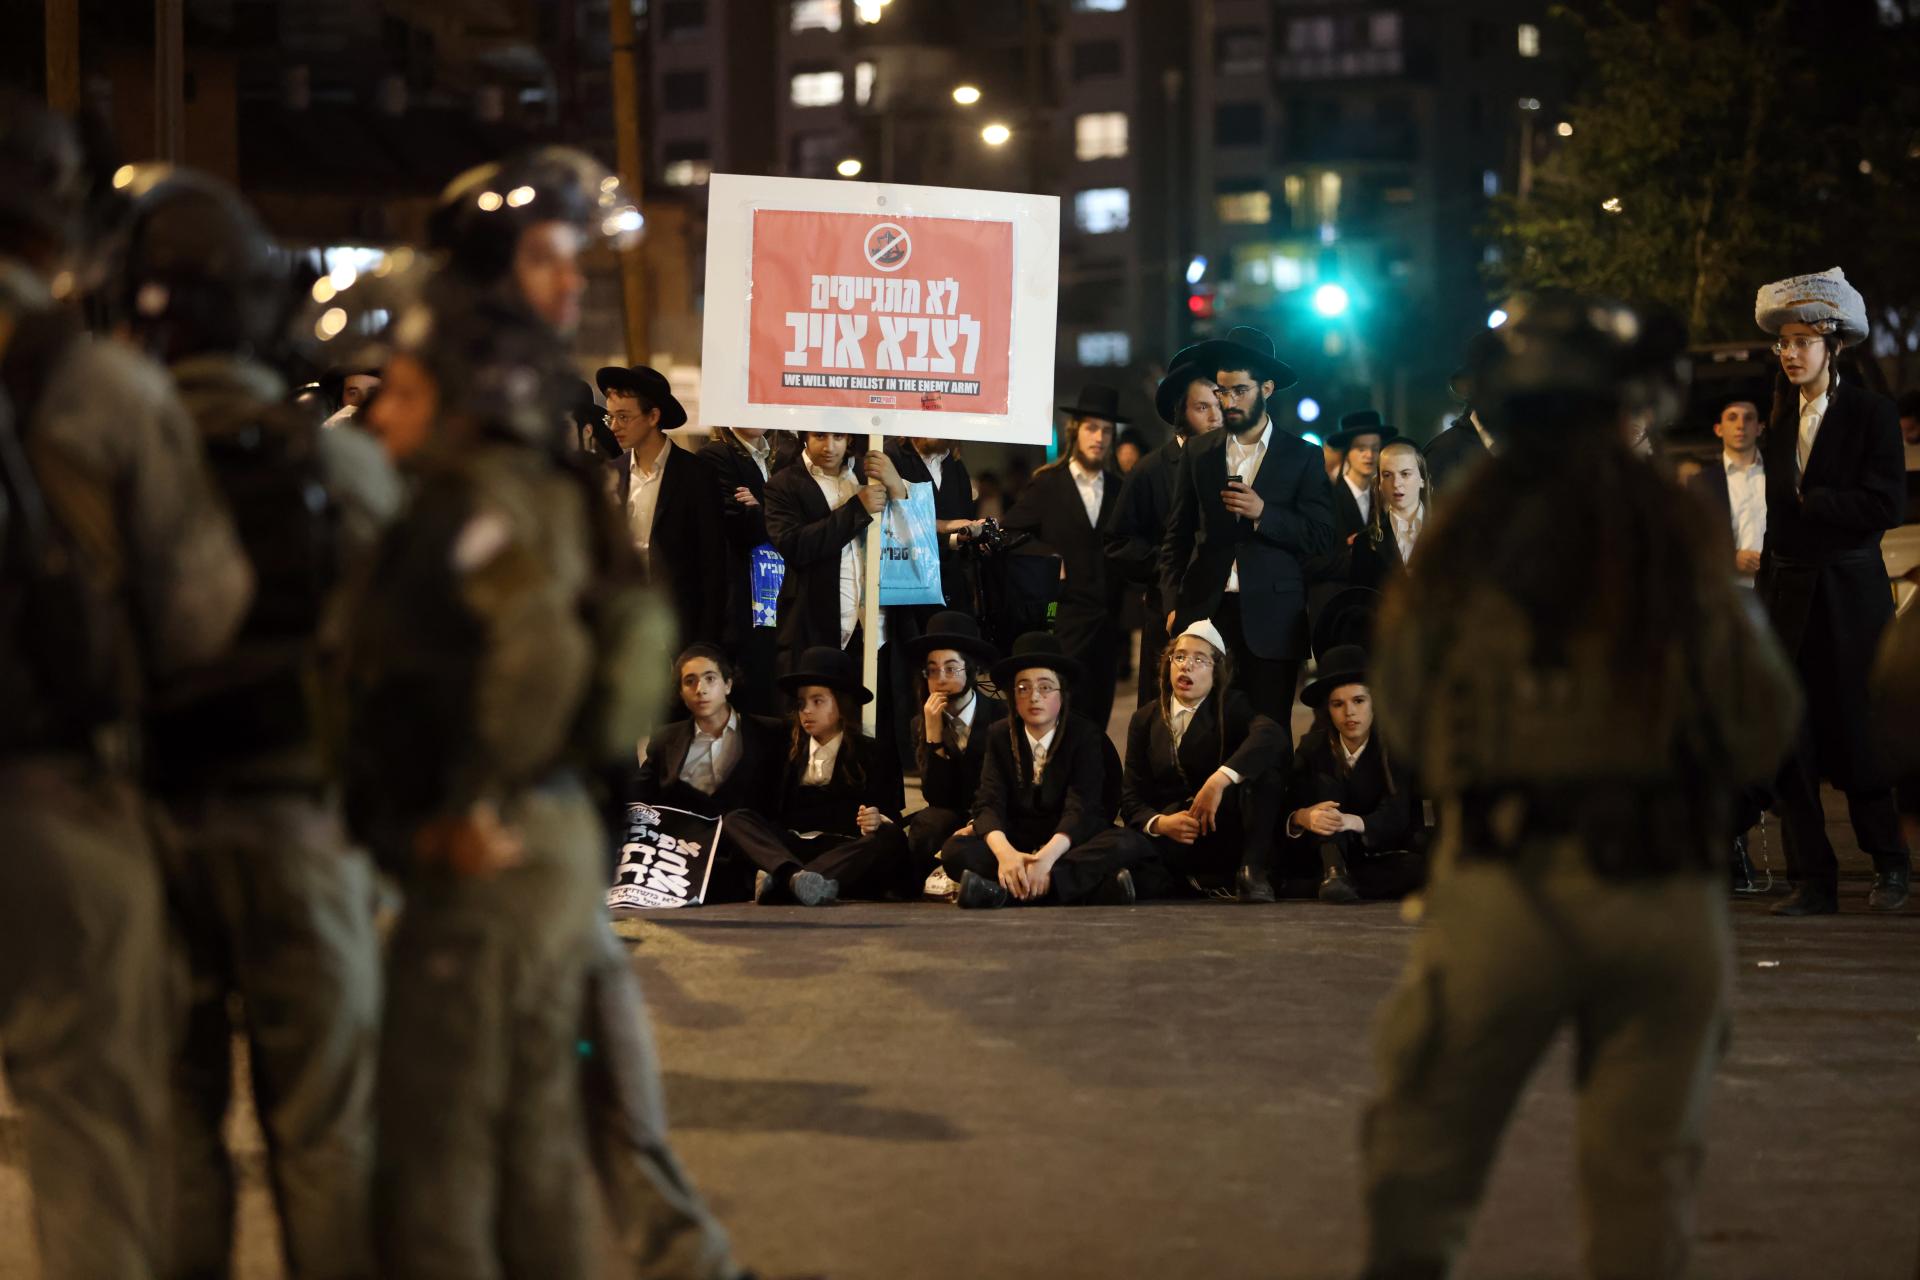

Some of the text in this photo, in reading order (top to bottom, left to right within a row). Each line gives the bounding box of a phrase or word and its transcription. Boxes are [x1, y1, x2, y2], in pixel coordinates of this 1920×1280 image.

[811, 275, 959, 315] לא מתגייסים
[784, 312, 981, 375] לצבא אויב
[784, 373, 979, 394] WE WILL NOT ENLIST IN THE ENEMY ARMY
